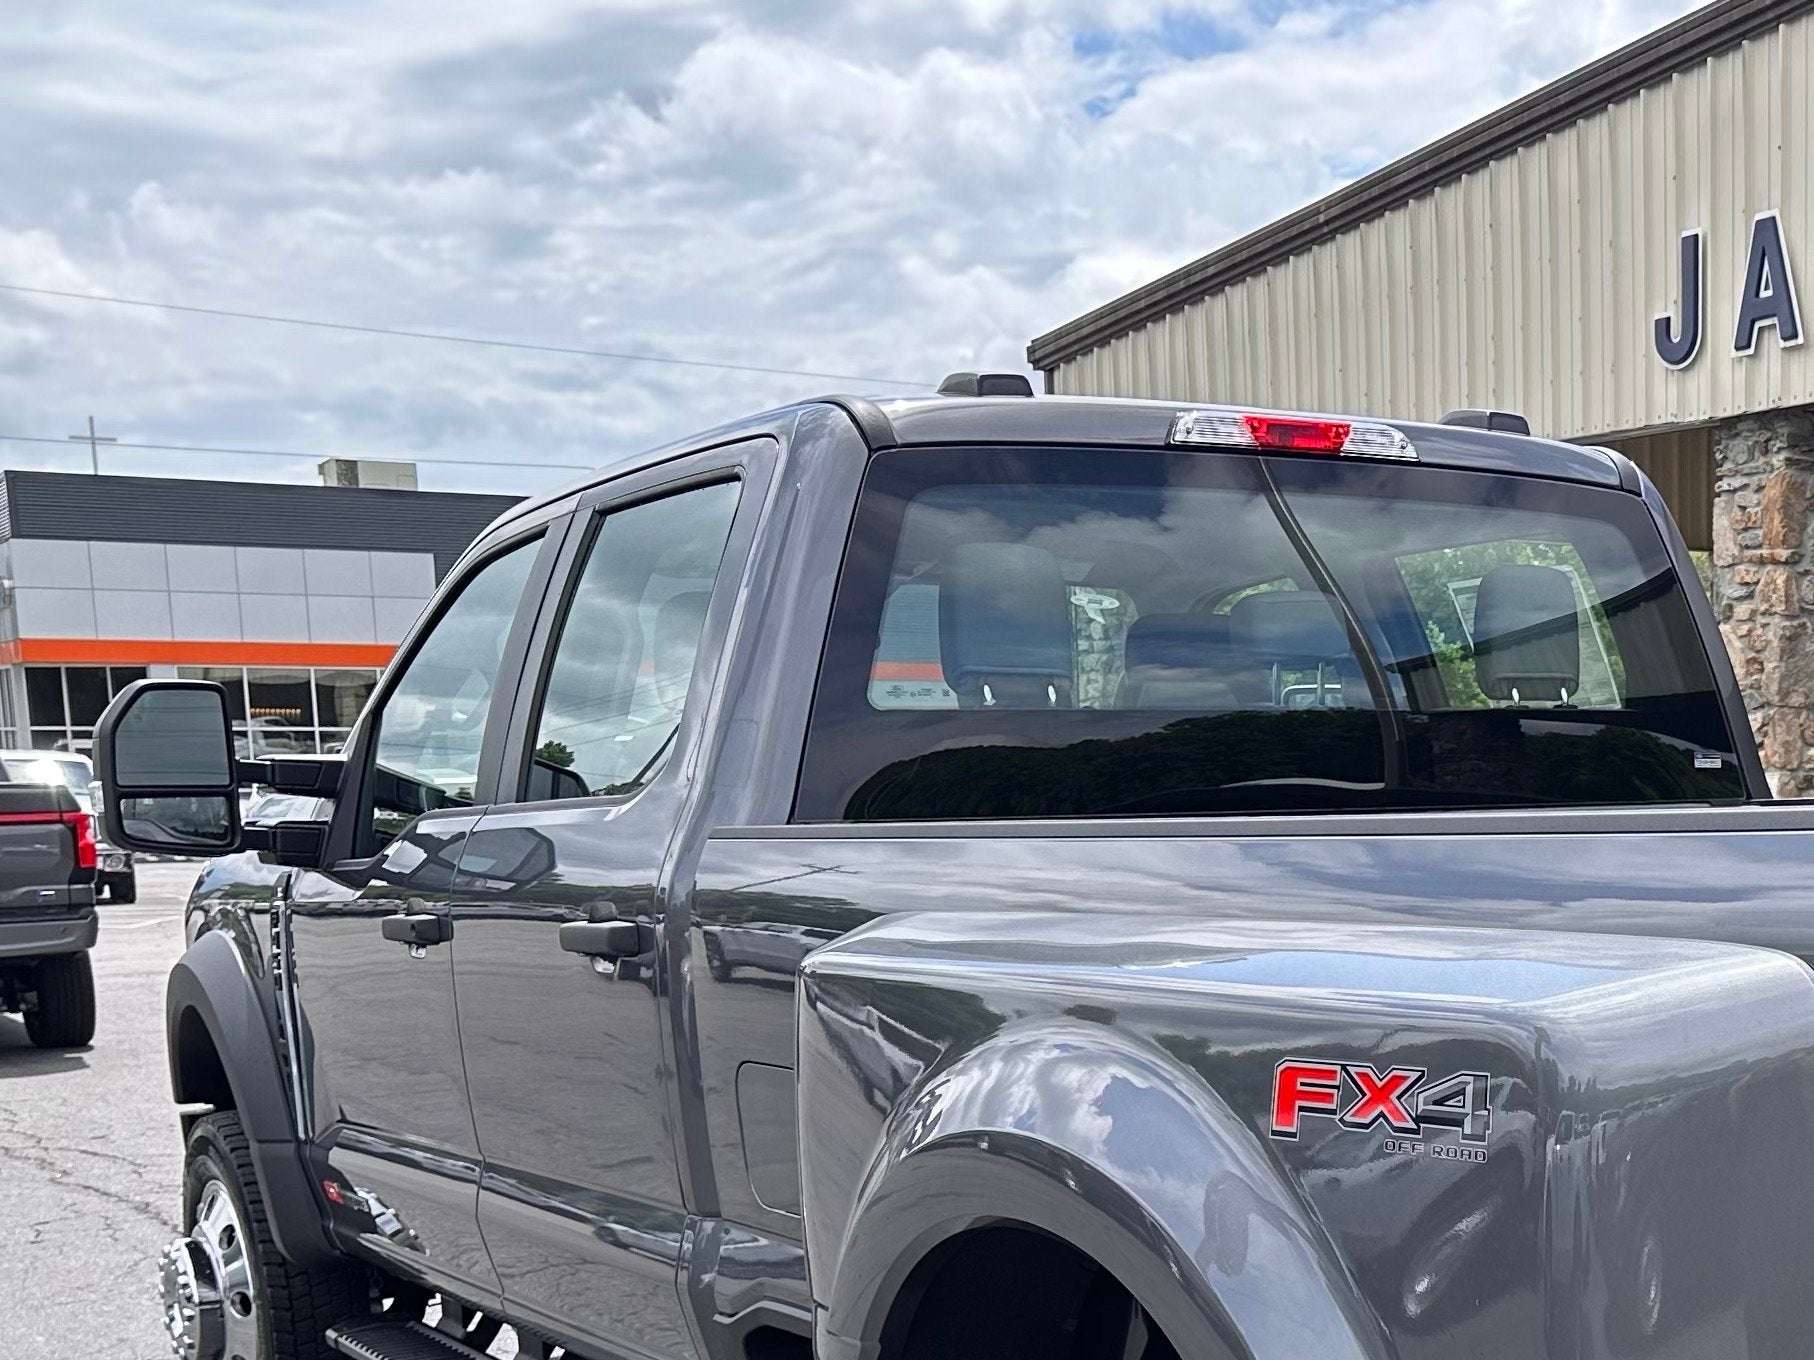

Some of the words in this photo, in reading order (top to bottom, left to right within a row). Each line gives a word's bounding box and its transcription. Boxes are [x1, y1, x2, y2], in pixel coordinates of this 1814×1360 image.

[1269, 1056, 1492, 1146] FX4
[1383, 1139, 1424, 1156] OFF
[1430, 1145, 1488, 1163] ROAD
